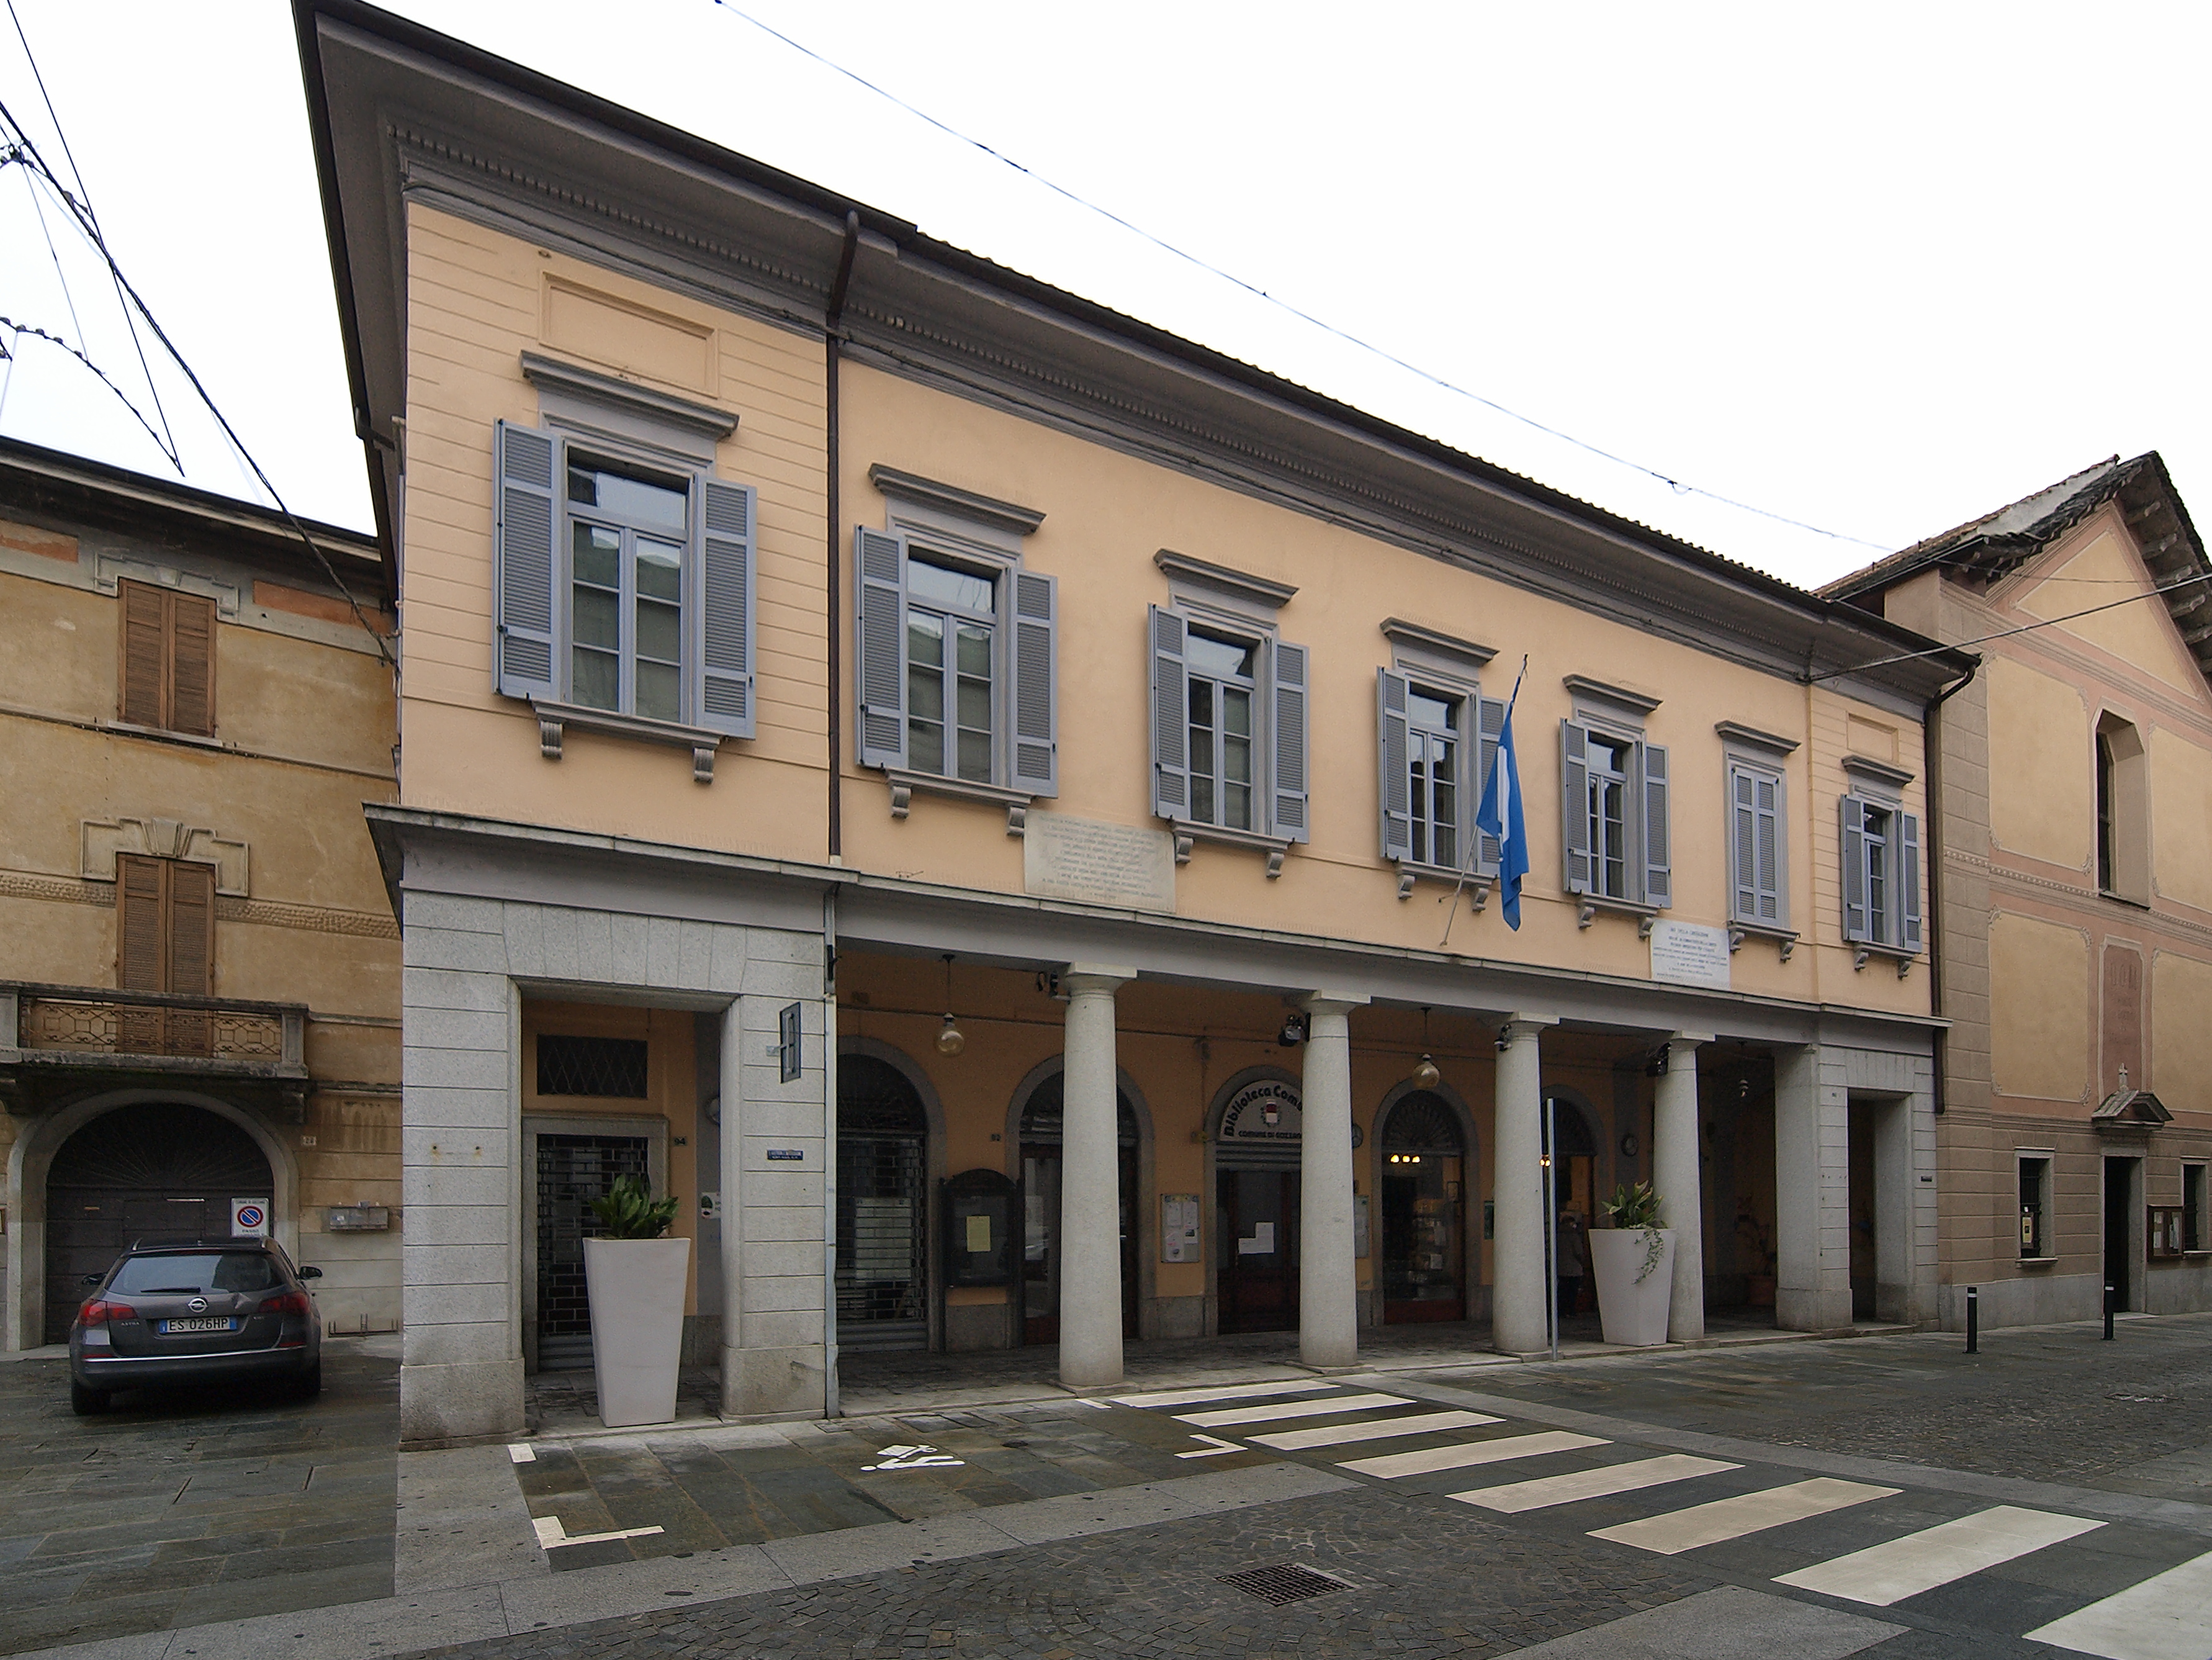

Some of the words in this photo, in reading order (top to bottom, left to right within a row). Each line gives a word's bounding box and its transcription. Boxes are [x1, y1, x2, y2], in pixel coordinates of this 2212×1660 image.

[1224, 1087, 1271, 1136] Biblioteca
[169, 1320, 184, 1331] ES
[189, 1318, 228, 1330] 026HP
